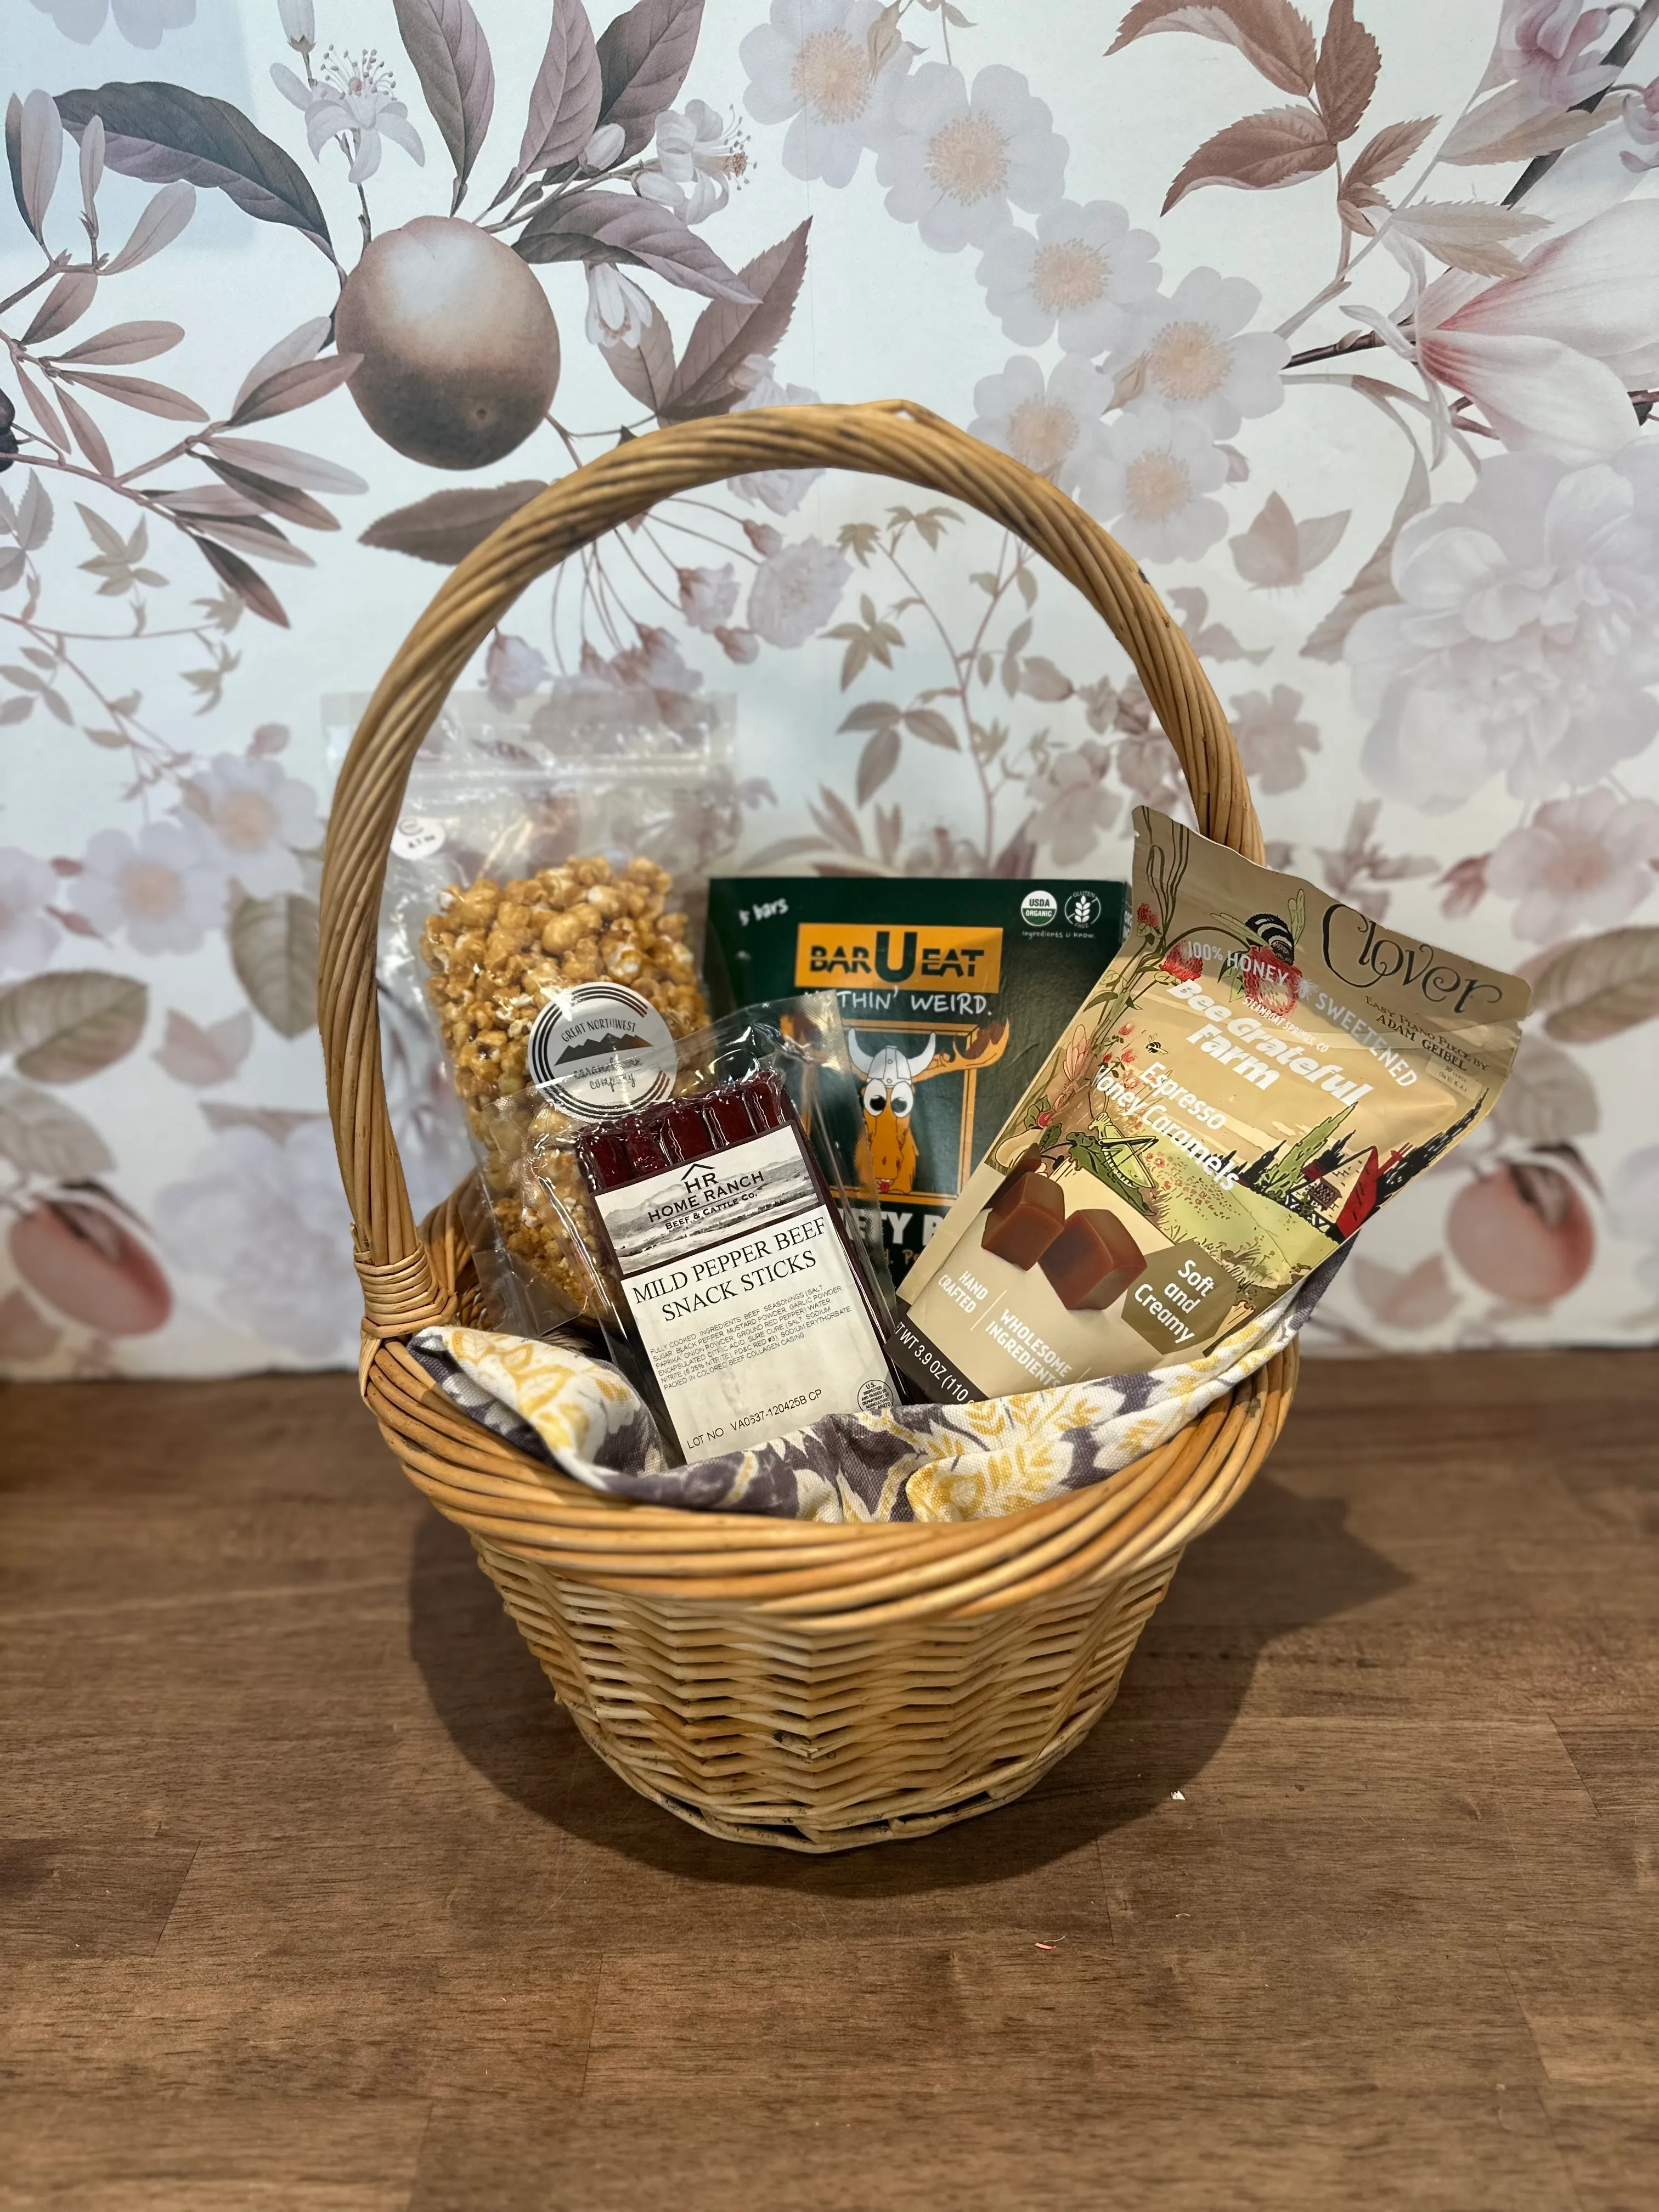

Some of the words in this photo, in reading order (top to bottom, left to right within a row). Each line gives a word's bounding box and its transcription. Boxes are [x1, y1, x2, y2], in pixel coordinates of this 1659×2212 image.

[753, 898, 789, 921] bars
[1029, 899, 1050, 907] USDA
[1322, 904, 1503, 1013] Clover
[561, 1023, 586, 1042] GREAT
[911, 992, 992, 1016] WEIRD.
[1187, 940, 1223, 961] 100%
[1227, 950, 1289, 986] HONEY
[1315, 992, 1417, 1086] SWEETENED
[1243, 996, 1285, 1026] STEAMBOAT
[1316, 1042, 1329, 1053] CO
[1186, 1023, 1279, 1091] Farm
[1365, 995, 1395, 1018] EASY
[1399, 1014, 1435, 1040] PIANO
[1438, 1035, 1471, 1062] PIECE
[1473, 1058, 1490, 1071] BY
[1376, 1014, 1415, 1041] ADAM
[1421, 1039, 1467, 1071] GEIBEL
[1139, 1062, 1227, 1130] Espresso
[1091, 1065, 1148, 1116] Honey
[1142, 1105, 1239, 1190] Caramels
[648, 1195, 700, 1223] HOME
[704, 1171, 764, 1202] RANCH
[684, 1172, 719, 1194] HR
[665, 1216, 690, 1230] BEEF
[703, 1198, 739, 1216] CATTLE
[632, 1272, 688, 1304] MILD
[691, 1240, 772, 1282] PEPPER
[773, 1216, 825, 1251] BEEF
[662, 1280, 738, 1322] SNACK
[741, 1249, 816, 1292] STICKS
[958, 1271, 988, 1300] HAND
[1177, 1260, 1214, 1297] Soft
[669, 1334, 697, 1348] COOKED
[764, 1292, 804, 1312] SEASONINGS
[938, 1274, 977, 1313] CRAFTED
[1135, 1284, 1195, 1344] Creamy
[1164, 1283, 1201, 1314] and
[661, 1371, 683, 1383] NITRITE
[752, 1339, 767, 1348] RED
[780, 1323, 806, 1338] SODIUM
[675, 1341, 697, 1354] BLACK
[726, 1318, 757, 1335] MUSTARD
[789, 1297, 812, 1310] GARLIC
[684, 1347, 705, 1358] ONION
[737, 1324, 764, 1339] GROUND
[764, 1318, 778, 1328] RED
[748, 1331, 765, 1342] SURE
[766, 1324, 785, 1335] CURE
[1000, 1308, 1072, 1378] WHOLESOME
[663, 1377, 687, 1390] PACKED
[728, 1355, 744, 1366] BEEF
[746, 1341, 781, 1359] COLLAGEN
[900, 1328, 919, 1349] WT
[914, 1345, 932, 1364] 3.9
[929, 1360, 947, 1380] OZ
[941, 1374, 968, 1401] (110
[687, 1434, 705, 1449] LOT
[808, 1389, 822, 1401] CP
